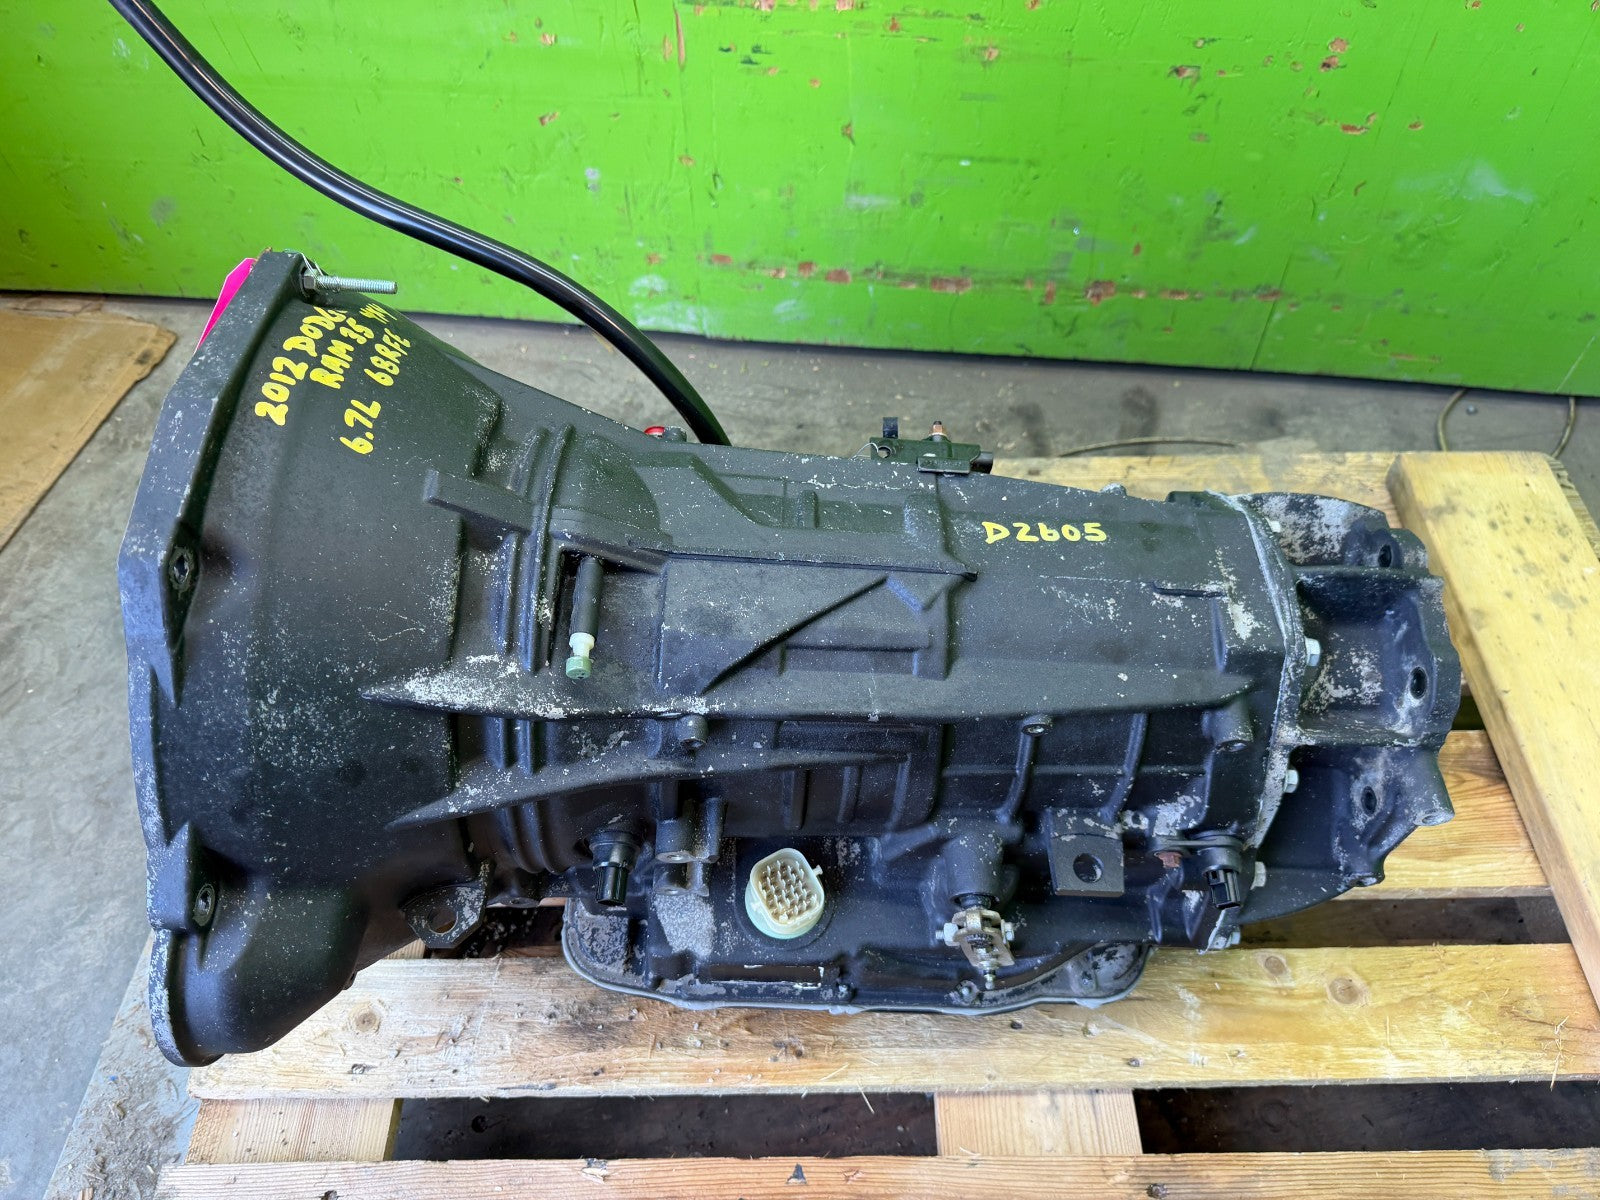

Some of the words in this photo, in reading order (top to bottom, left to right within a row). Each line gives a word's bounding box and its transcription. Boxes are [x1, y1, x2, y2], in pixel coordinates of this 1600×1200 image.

[254, 356, 309, 427] 2012
[283, 306, 348, 358] DODG
[309, 339, 355, 390] RAM
[339, 317, 375, 345] 35
[339, 399, 382, 455] 6.7L
[363, 328, 411, 387] 68RFE
